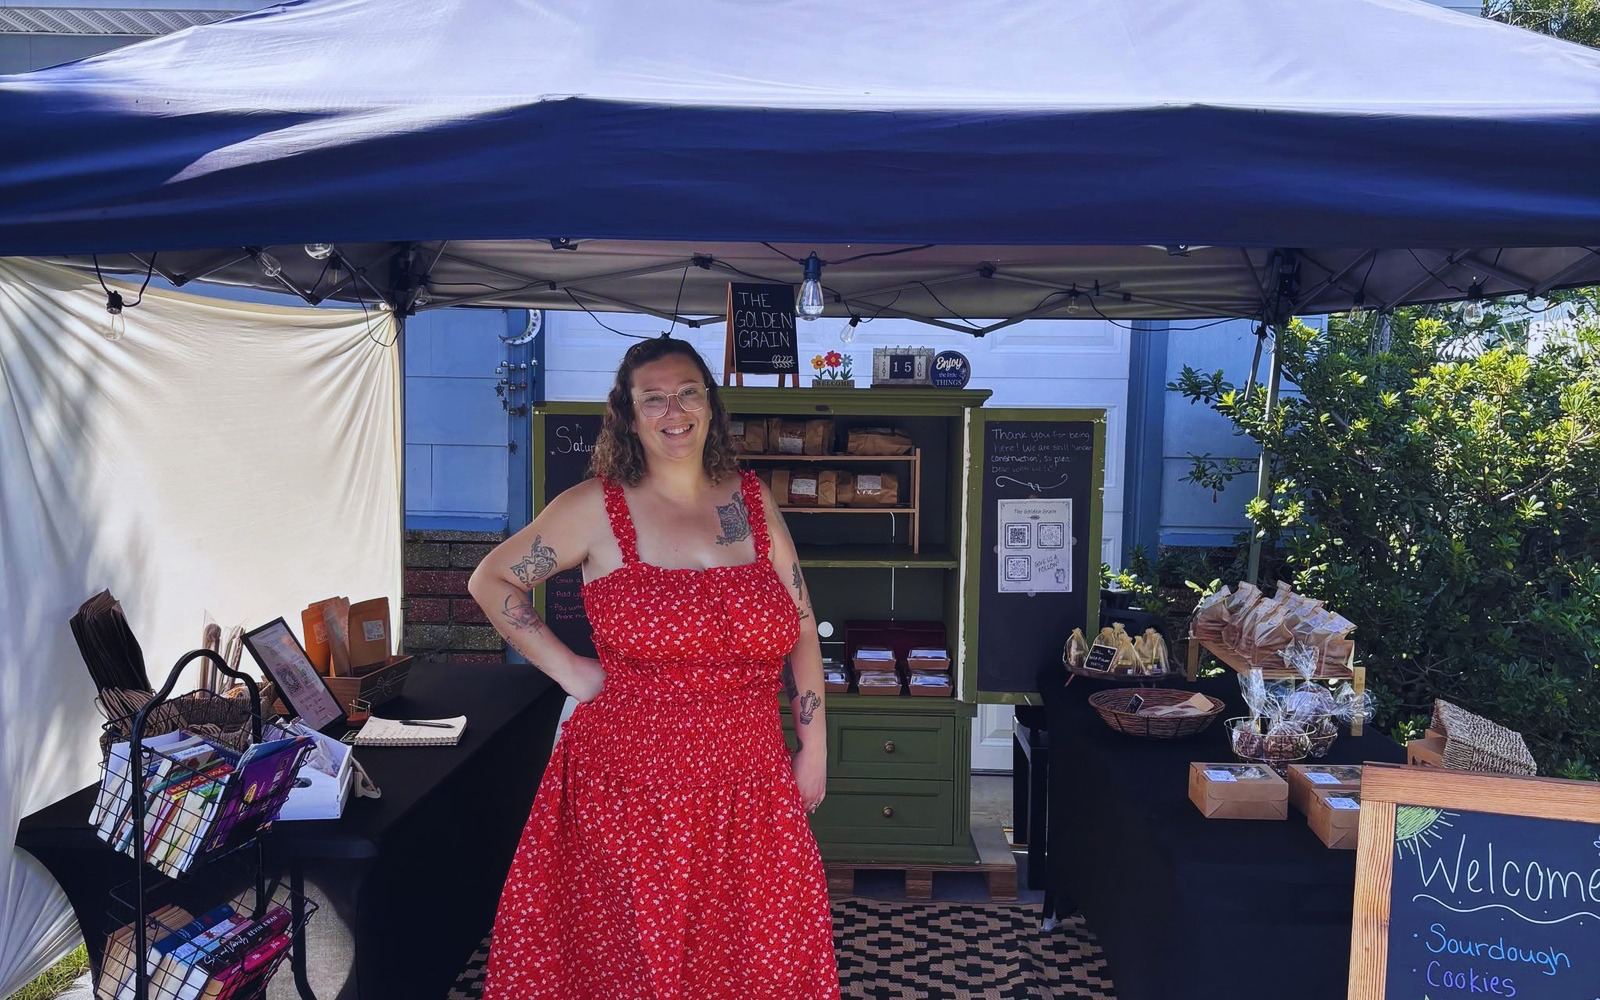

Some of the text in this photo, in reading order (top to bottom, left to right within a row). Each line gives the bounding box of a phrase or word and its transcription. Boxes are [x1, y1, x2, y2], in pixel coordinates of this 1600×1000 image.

[738, 292, 771, 308] THE
[735, 310, 794, 330] GOLDEN
[738, 329, 791, 349] GRAIN
[936, 356, 963, 371] Enjoy
[991, 429, 1090, 442] Thank you for being
[1022, 443, 1036, 452] We
[1413, 833, 1600, 902] Welcome
[247, 925, 264, 937] KEVIN
[263, 915, 278, 927] KWAN
[1425, 923, 1571, 976] Sourdough
[1426, 960, 1516, 998] Cookies
